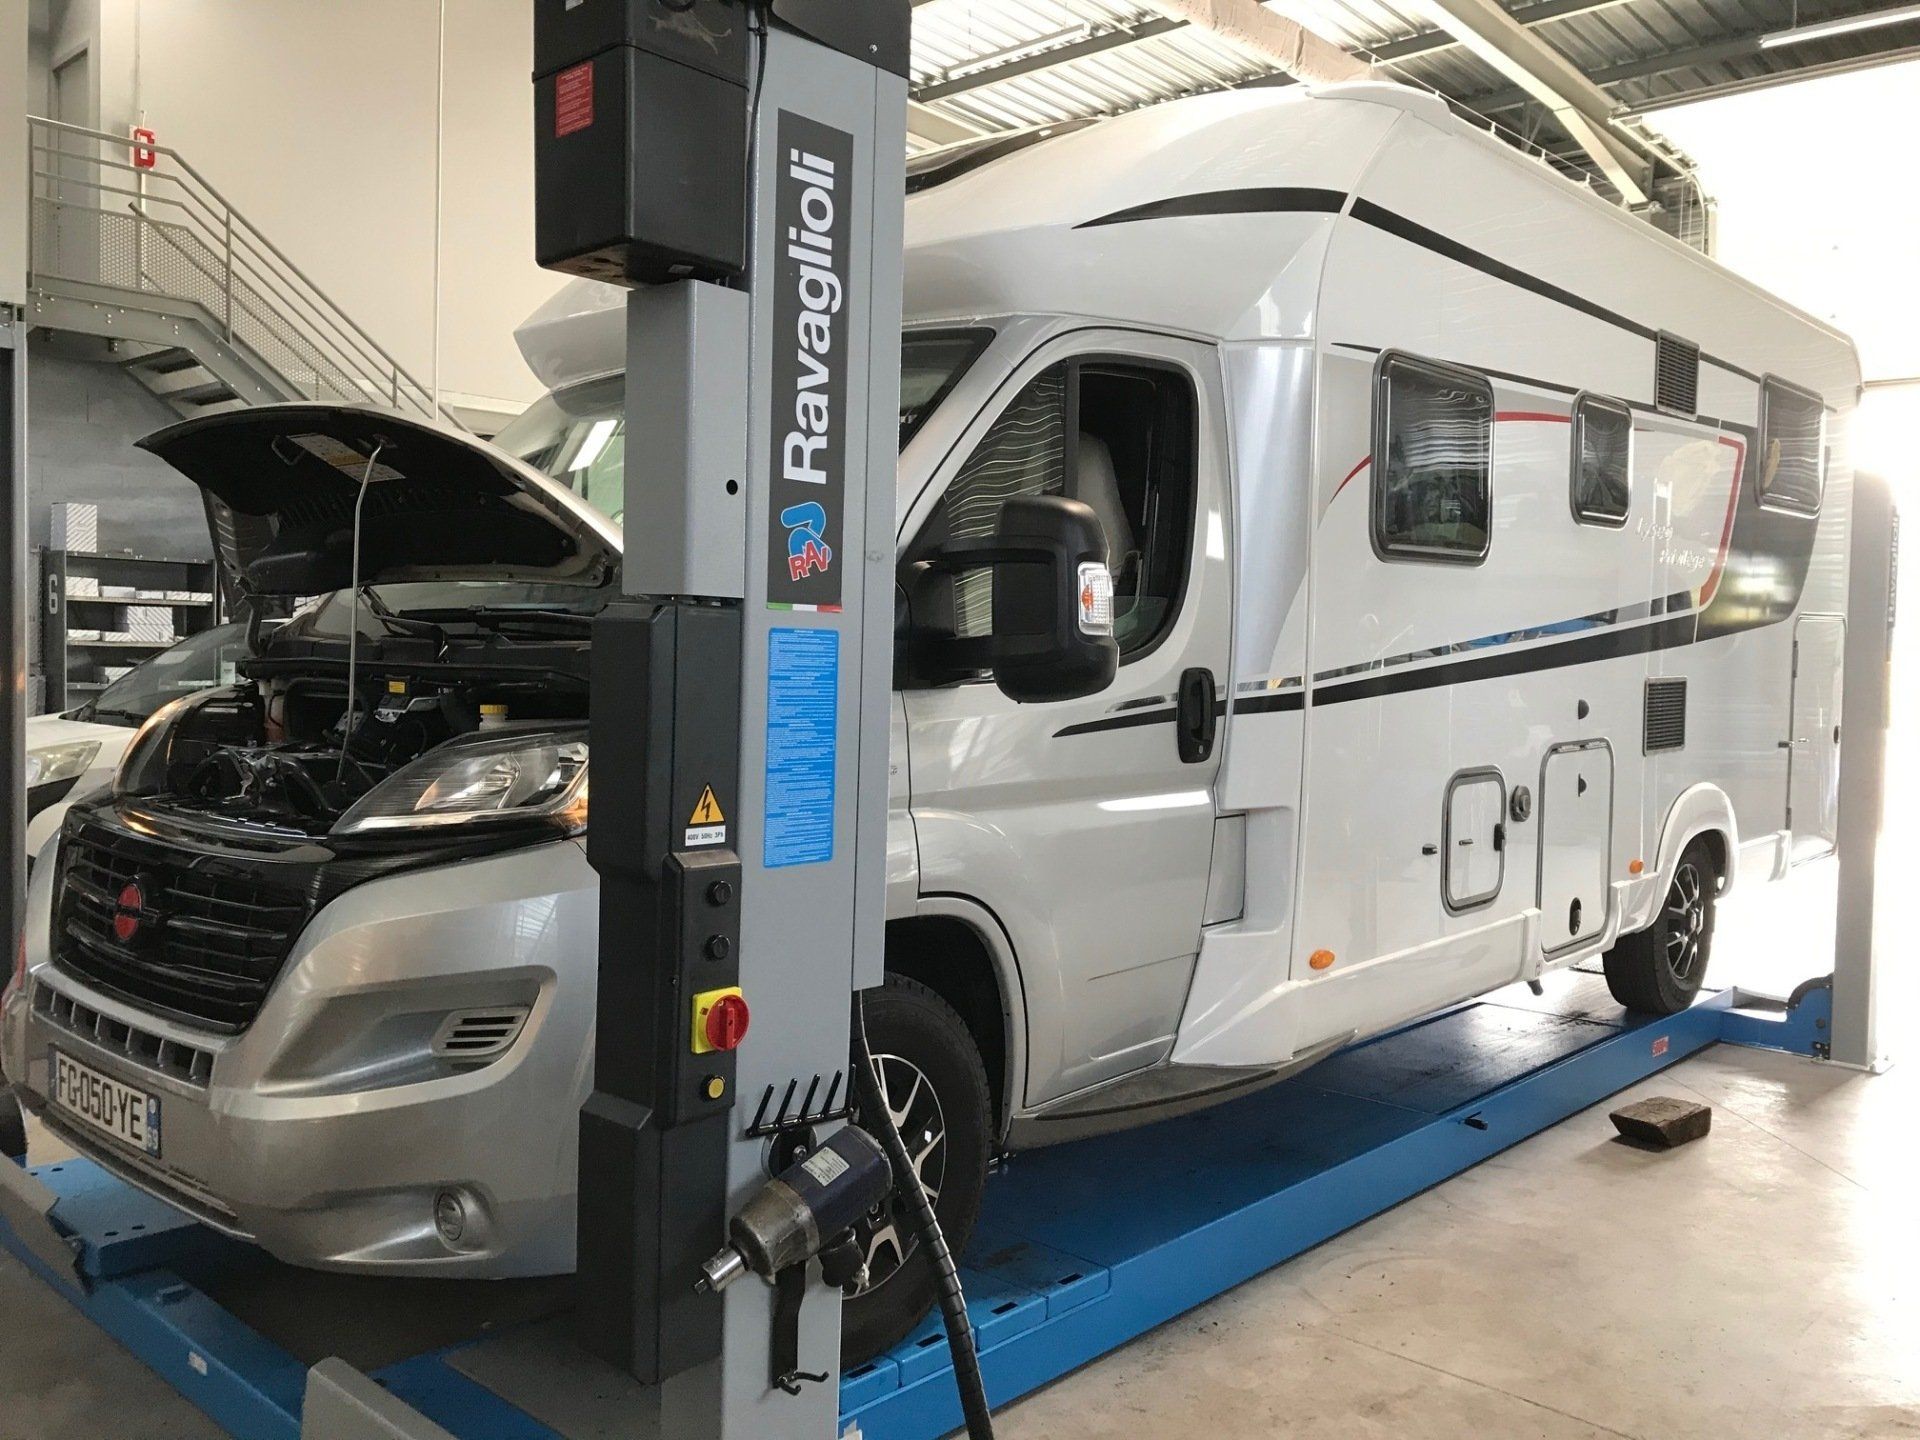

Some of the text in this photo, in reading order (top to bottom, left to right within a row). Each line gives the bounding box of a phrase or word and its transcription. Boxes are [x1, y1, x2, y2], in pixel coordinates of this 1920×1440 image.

[782, 146, 842, 486] Ravaglioli
[788, 540, 829, 581] RAV
[48, 574, 59, 615] 6
